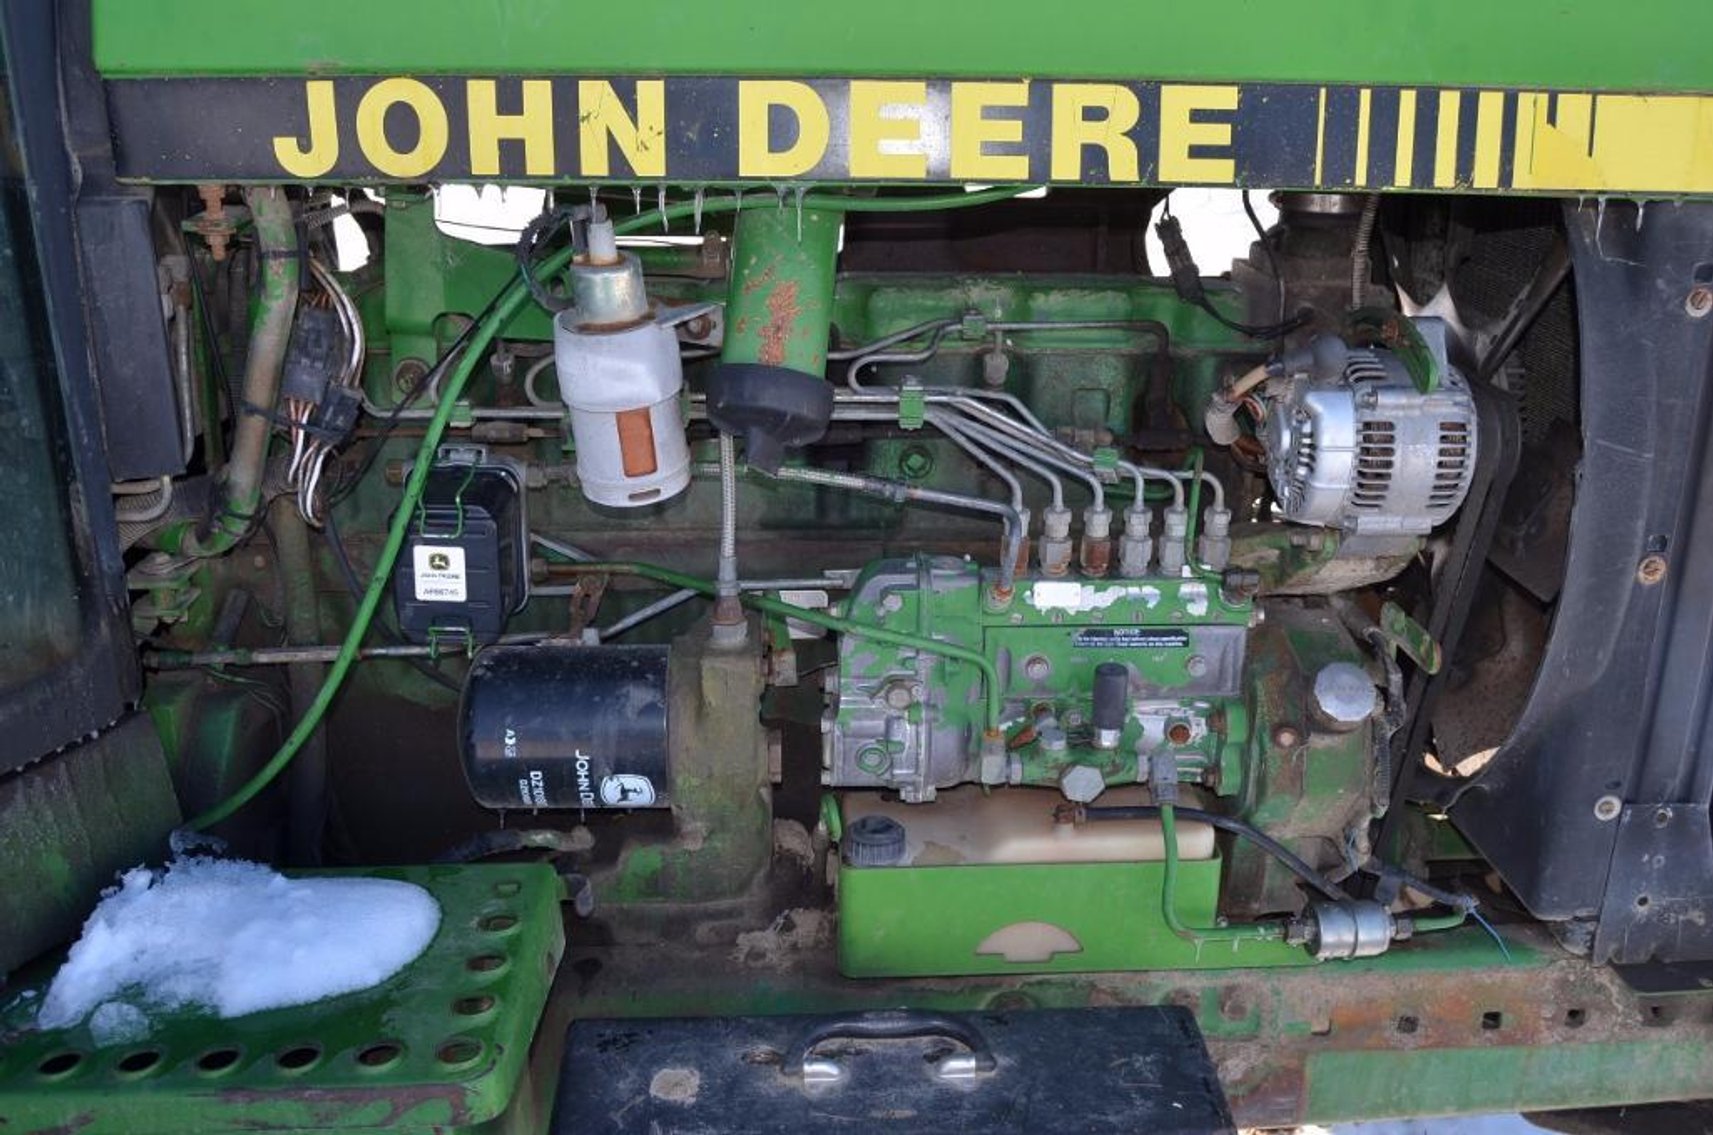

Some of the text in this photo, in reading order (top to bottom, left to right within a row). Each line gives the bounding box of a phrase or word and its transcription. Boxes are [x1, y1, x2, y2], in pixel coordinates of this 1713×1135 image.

[273, 78, 1239, 182] JOHN DEERE
[575, 749, 591, 791] JOHN
